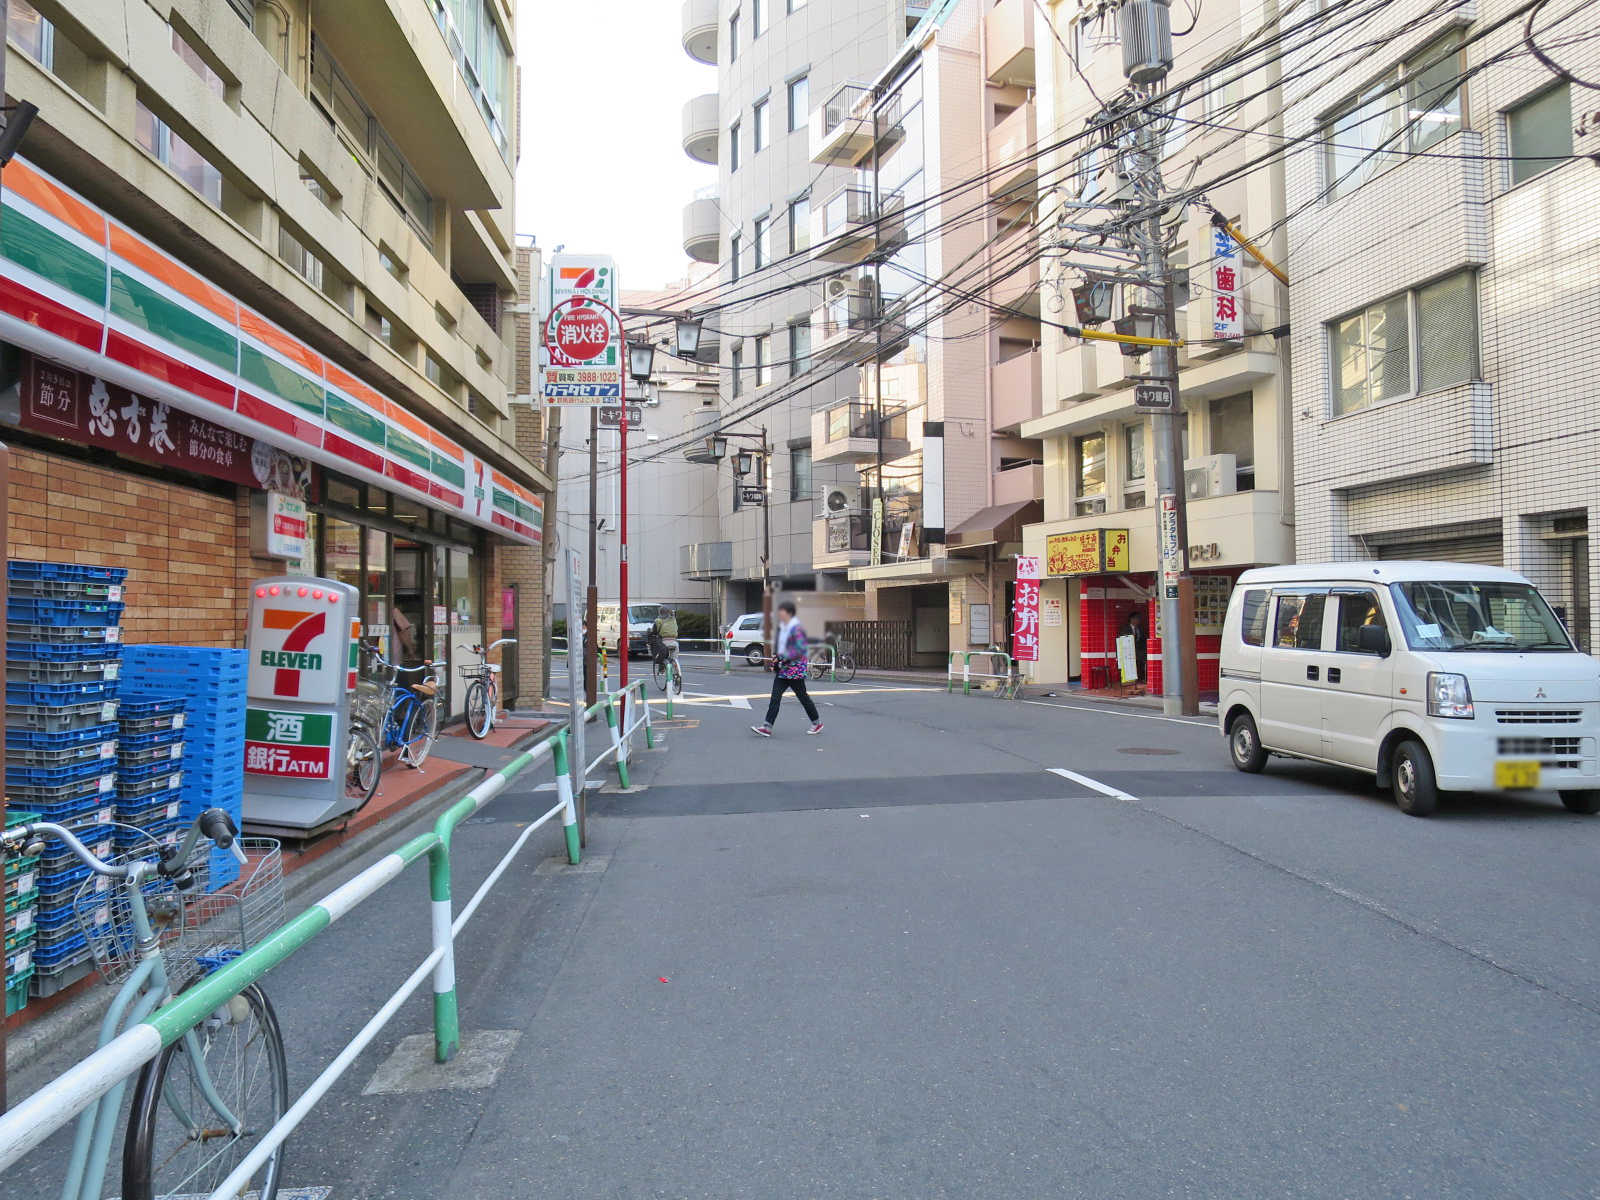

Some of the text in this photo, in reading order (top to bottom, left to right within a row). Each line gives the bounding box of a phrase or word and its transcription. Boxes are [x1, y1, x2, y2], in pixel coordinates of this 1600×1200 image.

[576, 313, 600, 321] HYDRANT
[1214, 323, 1229, 331] 2F
[560, 322, 606, 345] 消火栓
[39, 382, 72, 412] 節分
[546, 384, 617, 396] クラタセブン
[1136, 390, 1170, 402] トキワ銀座
[189, 419, 248, 453] みんなで楽しむ
[188, 438, 233, 467] 節分の食卓
[872, 510, 881, 566] CLOSED
[1106, 534, 1127, 568] お弁当
[1016, 583, 1039, 661] お弁当
[266, 712, 305, 742] 酒
